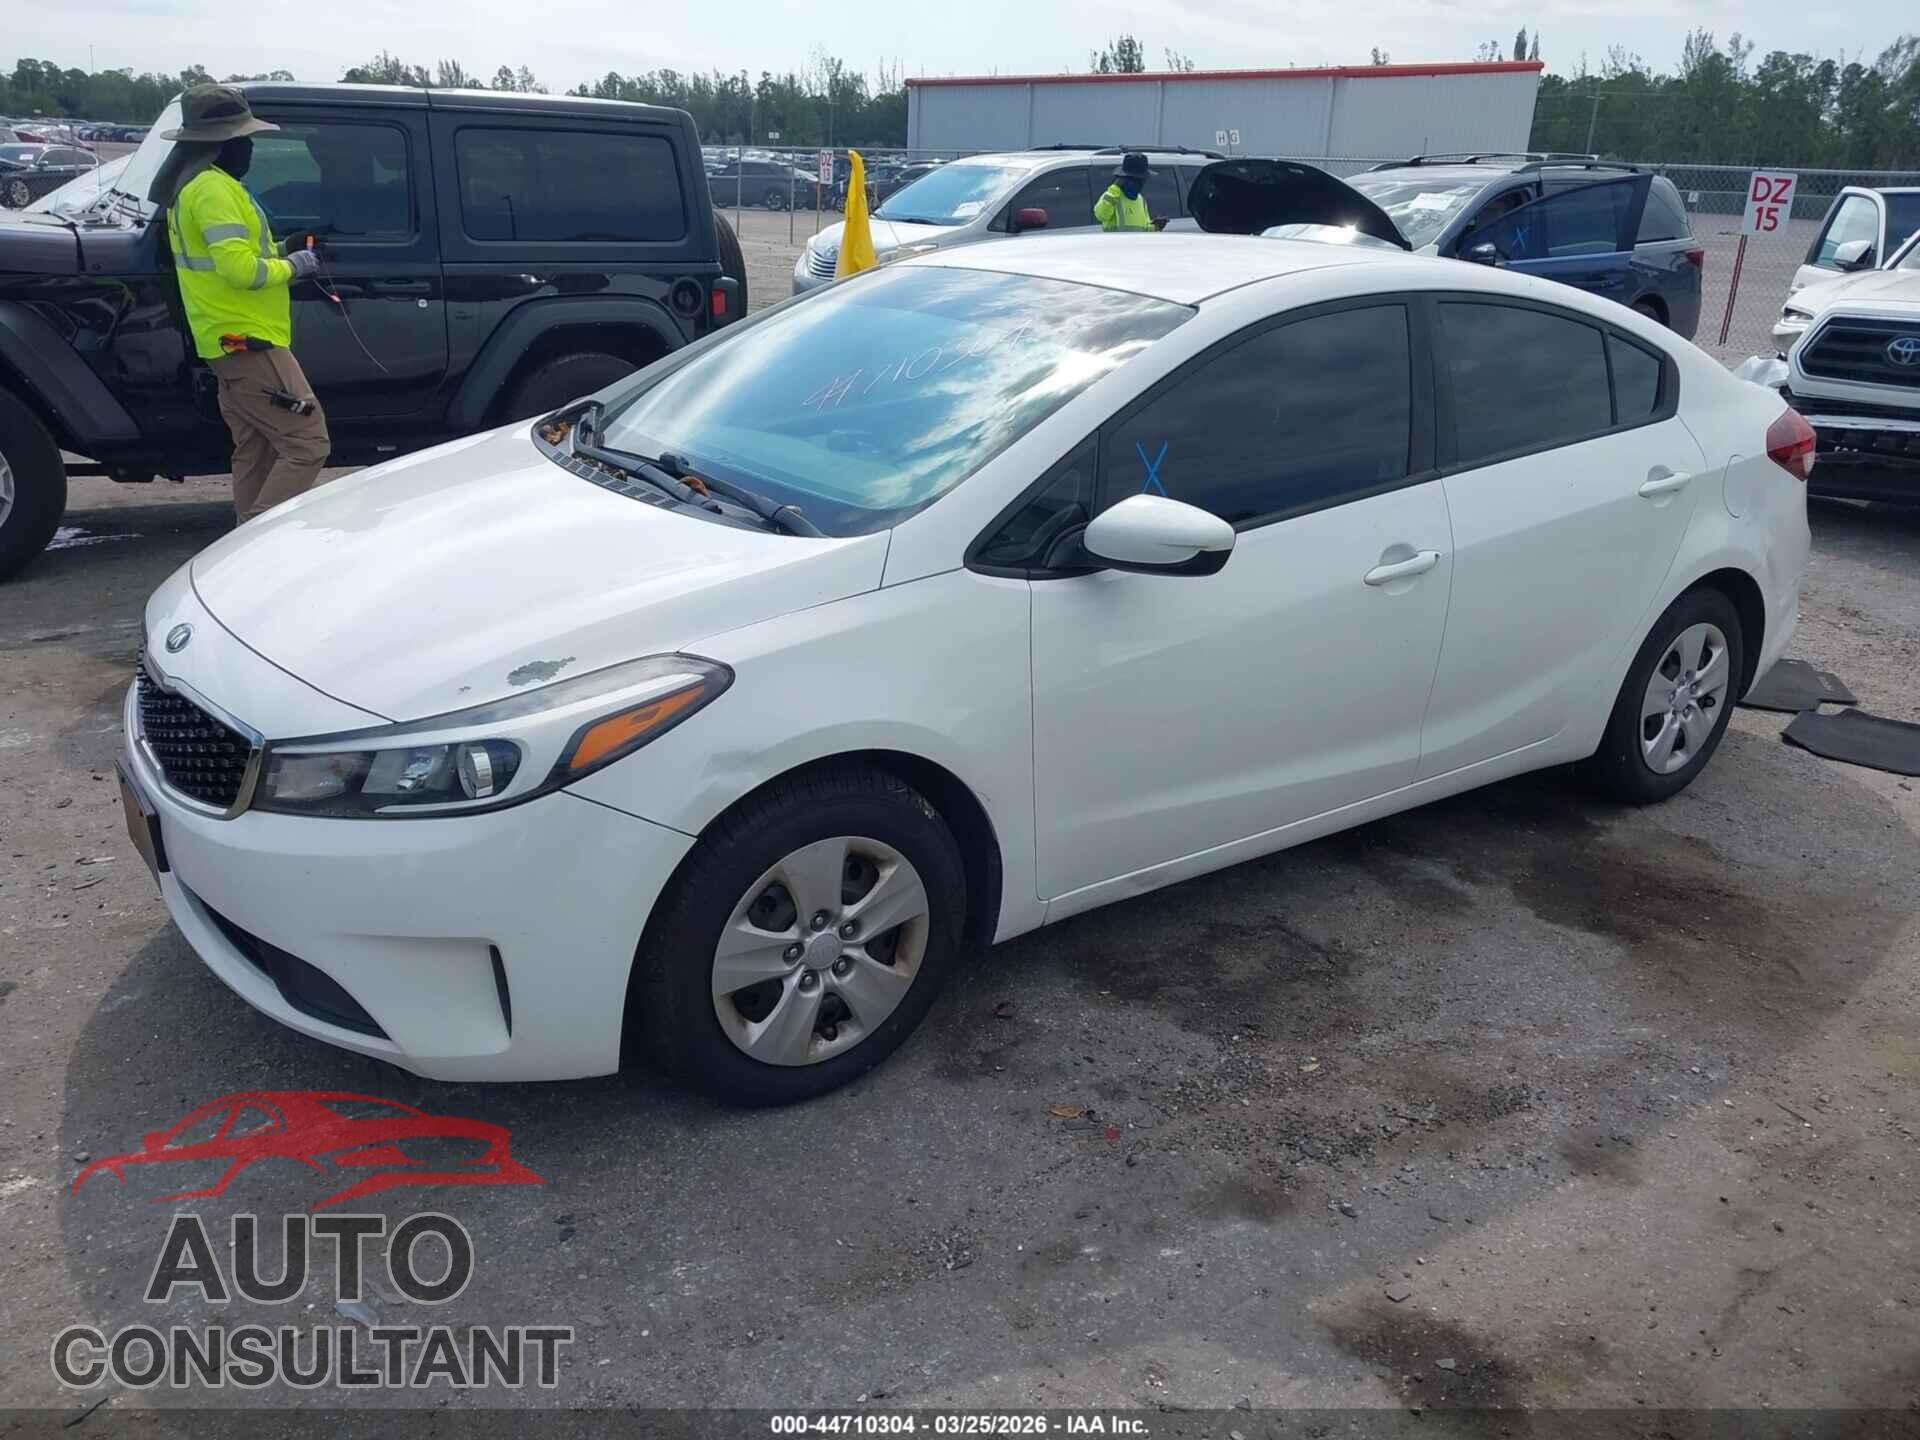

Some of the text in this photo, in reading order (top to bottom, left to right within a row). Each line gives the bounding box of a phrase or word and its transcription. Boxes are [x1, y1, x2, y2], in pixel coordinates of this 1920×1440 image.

[821, 152, 832, 166] DZ
[1751, 176, 1793, 204] DZ
[1755, 206, 1779, 231] 15
